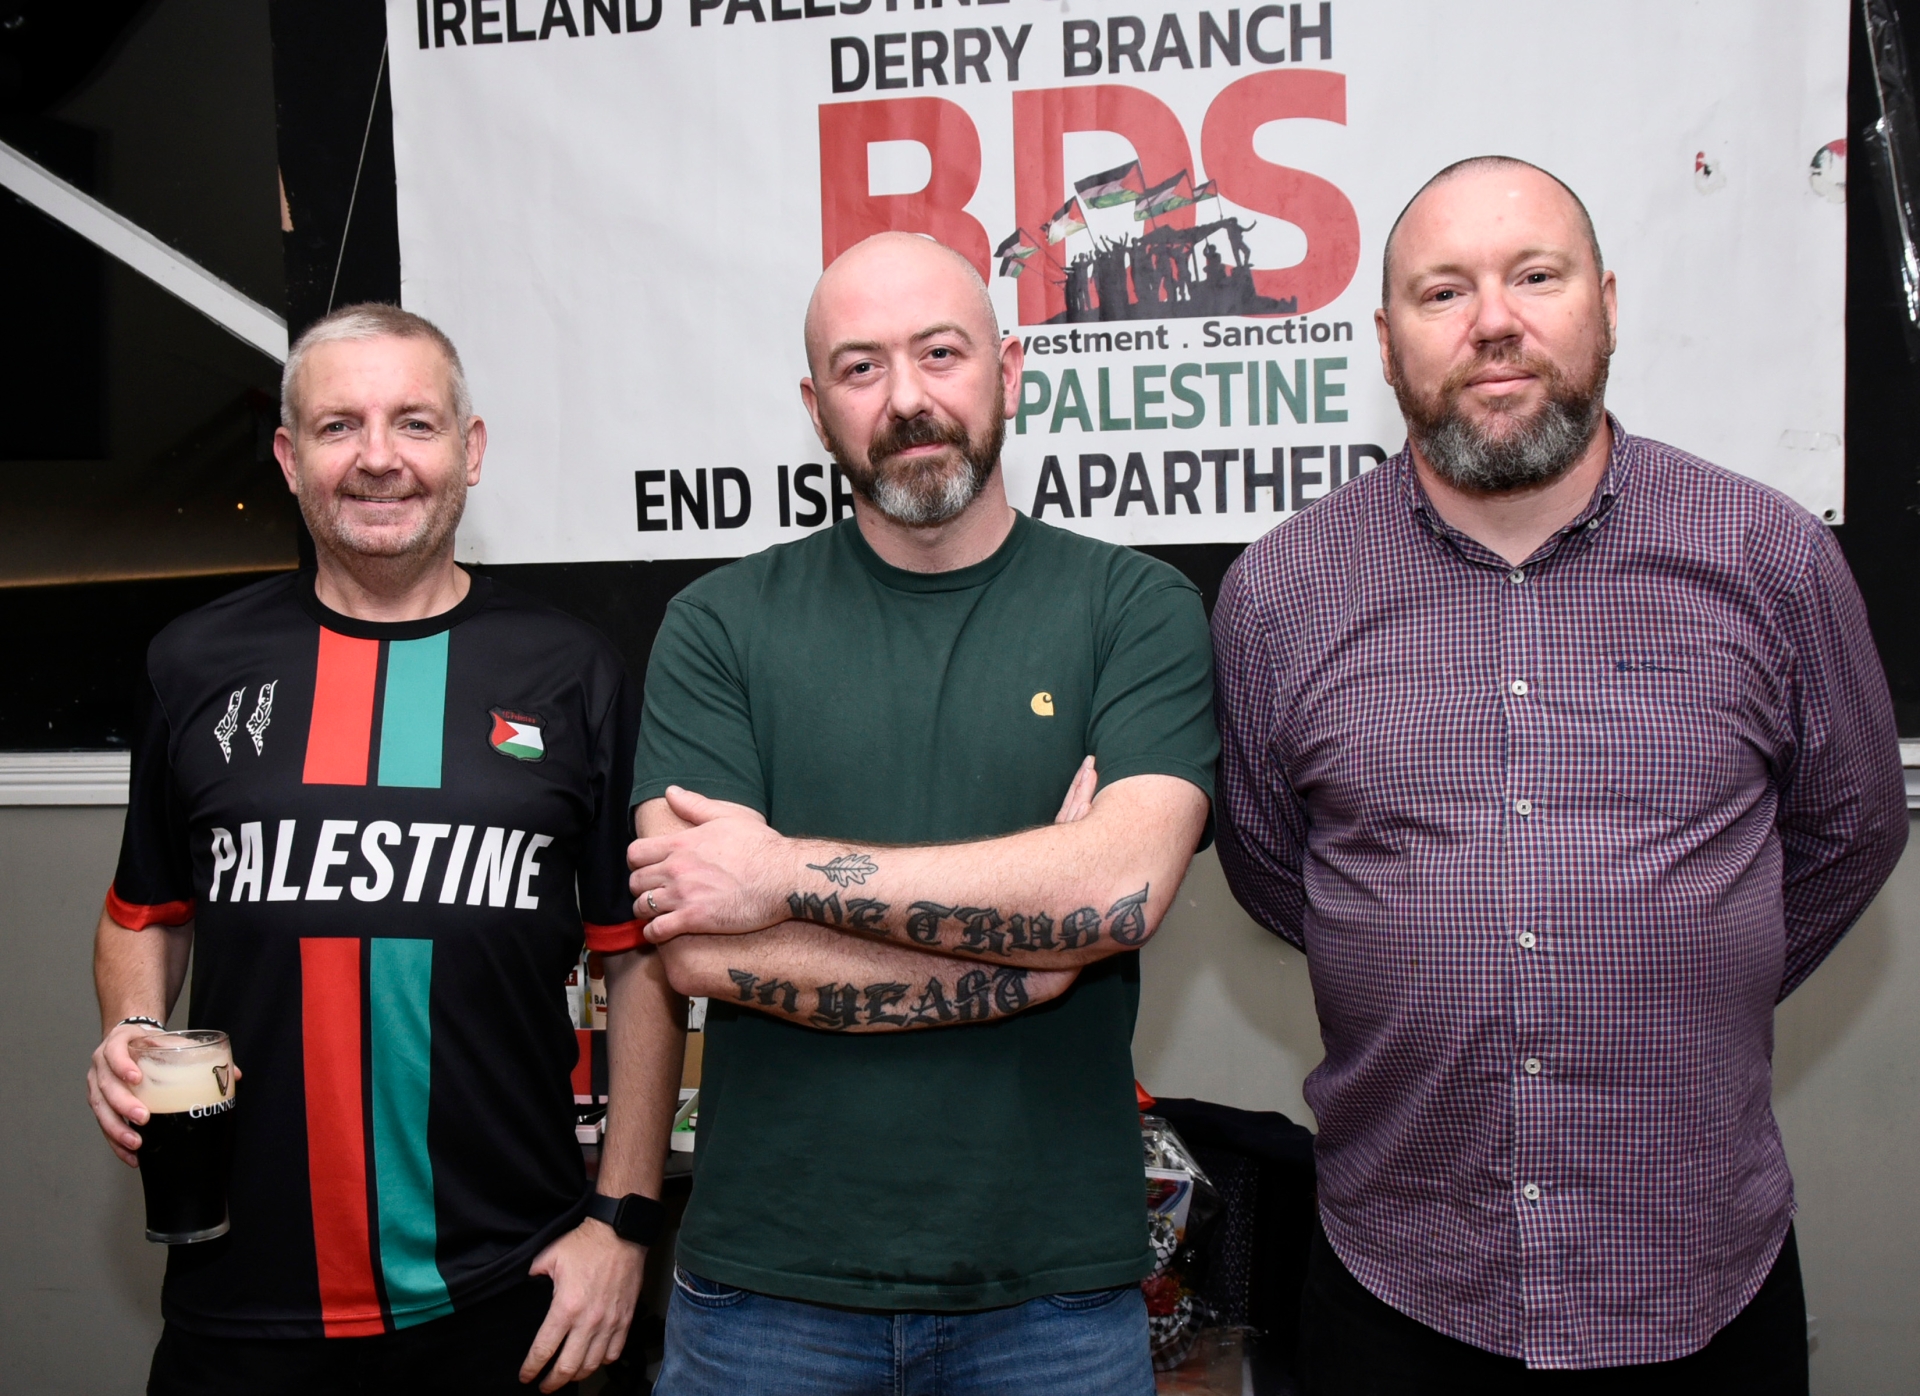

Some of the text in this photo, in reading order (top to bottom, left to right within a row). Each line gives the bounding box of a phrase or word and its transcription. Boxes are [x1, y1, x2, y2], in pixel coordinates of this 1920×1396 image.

[417, 0, 663, 50] IRELAND
[830, 1, 1333, 94] DERRY BRANCH
[818, 68, 1361, 326] BDS
[1002, 325, 1169, 355] vestment
[1203, 316, 1354, 348] Sanction
[1015, 356, 1349, 435] PALESTINE
[635, 467, 752, 532] END
[777, 463, 855, 528] ISR
[209, 819, 555, 910] PALESTINE
[906, 882, 1150, 957] TRUST
[808, 967, 1030, 1030] YEAST
